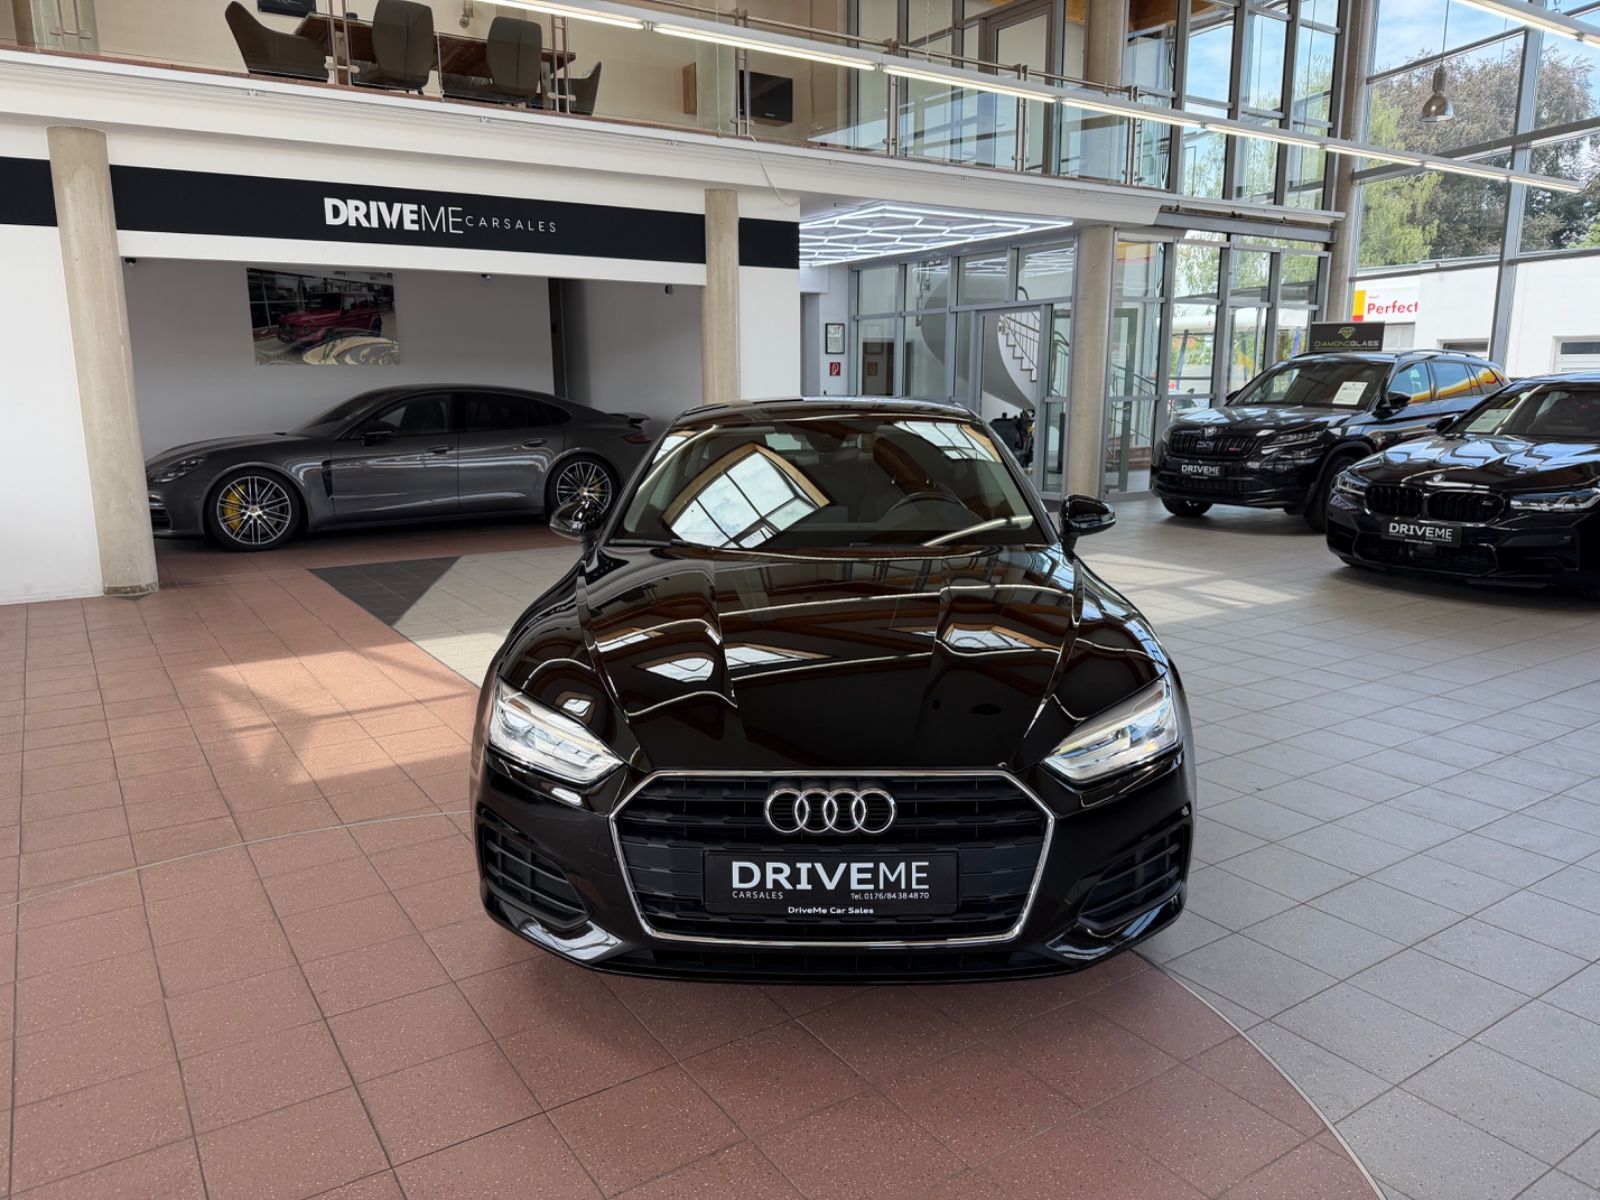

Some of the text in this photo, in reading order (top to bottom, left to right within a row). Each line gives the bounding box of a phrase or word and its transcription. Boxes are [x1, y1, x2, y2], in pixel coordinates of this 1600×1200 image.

[323, 197, 557, 234] DRIVEME CARSALES
[1367, 300, 1418, 315] Perfect
[1181, 464, 1220, 474] DRIVEME
[1389, 522, 1453, 539] DRIVEME
[732, 861, 930, 890] DRIVEME
[732, 891, 784, 900] CARSALES
[788, 906, 874, 914] DriveMe Car Sales
